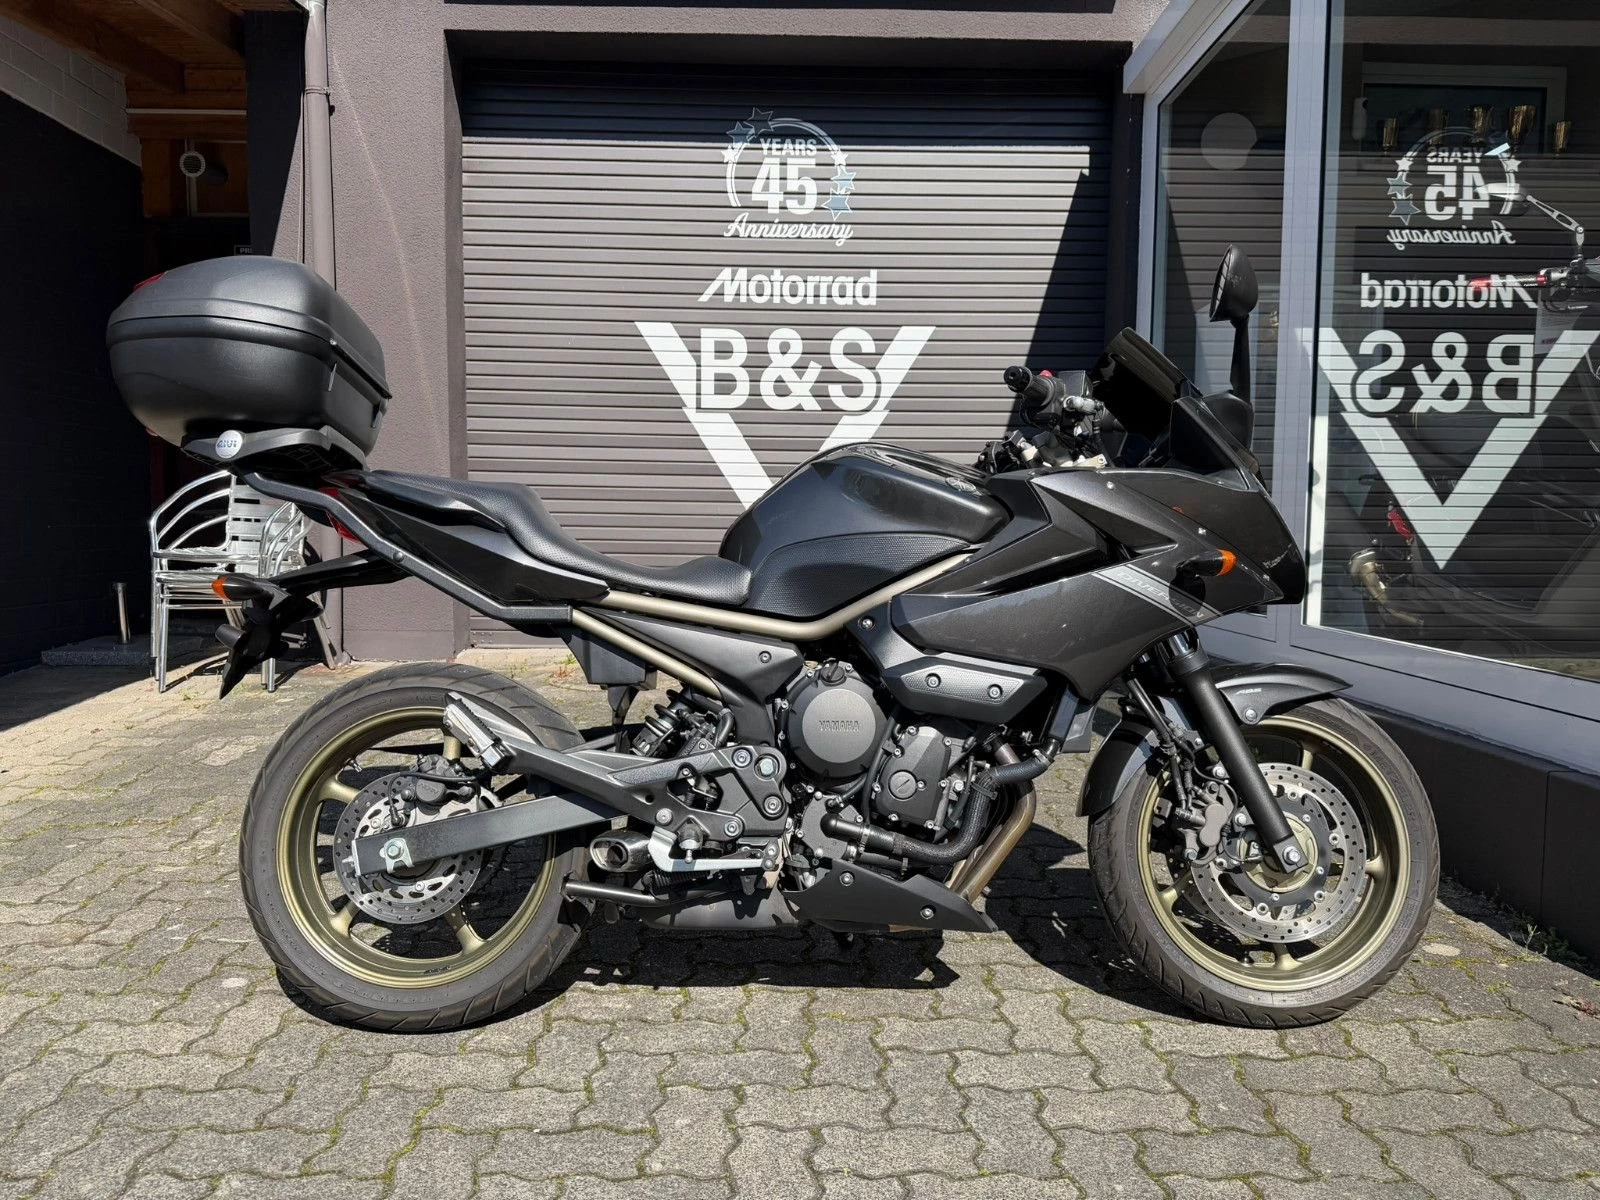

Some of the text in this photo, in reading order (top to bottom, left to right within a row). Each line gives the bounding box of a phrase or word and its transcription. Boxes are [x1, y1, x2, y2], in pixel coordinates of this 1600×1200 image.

[760, 138, 817, 156] YEARS
[751, 157, 817, 214] 45
[724, 212, 853, 246] Anniversary
[697, 267, 878, 306] Motorrad
[700, 327, 877, 411] B&S
[819, 720, 860, 732] YAMAHA
